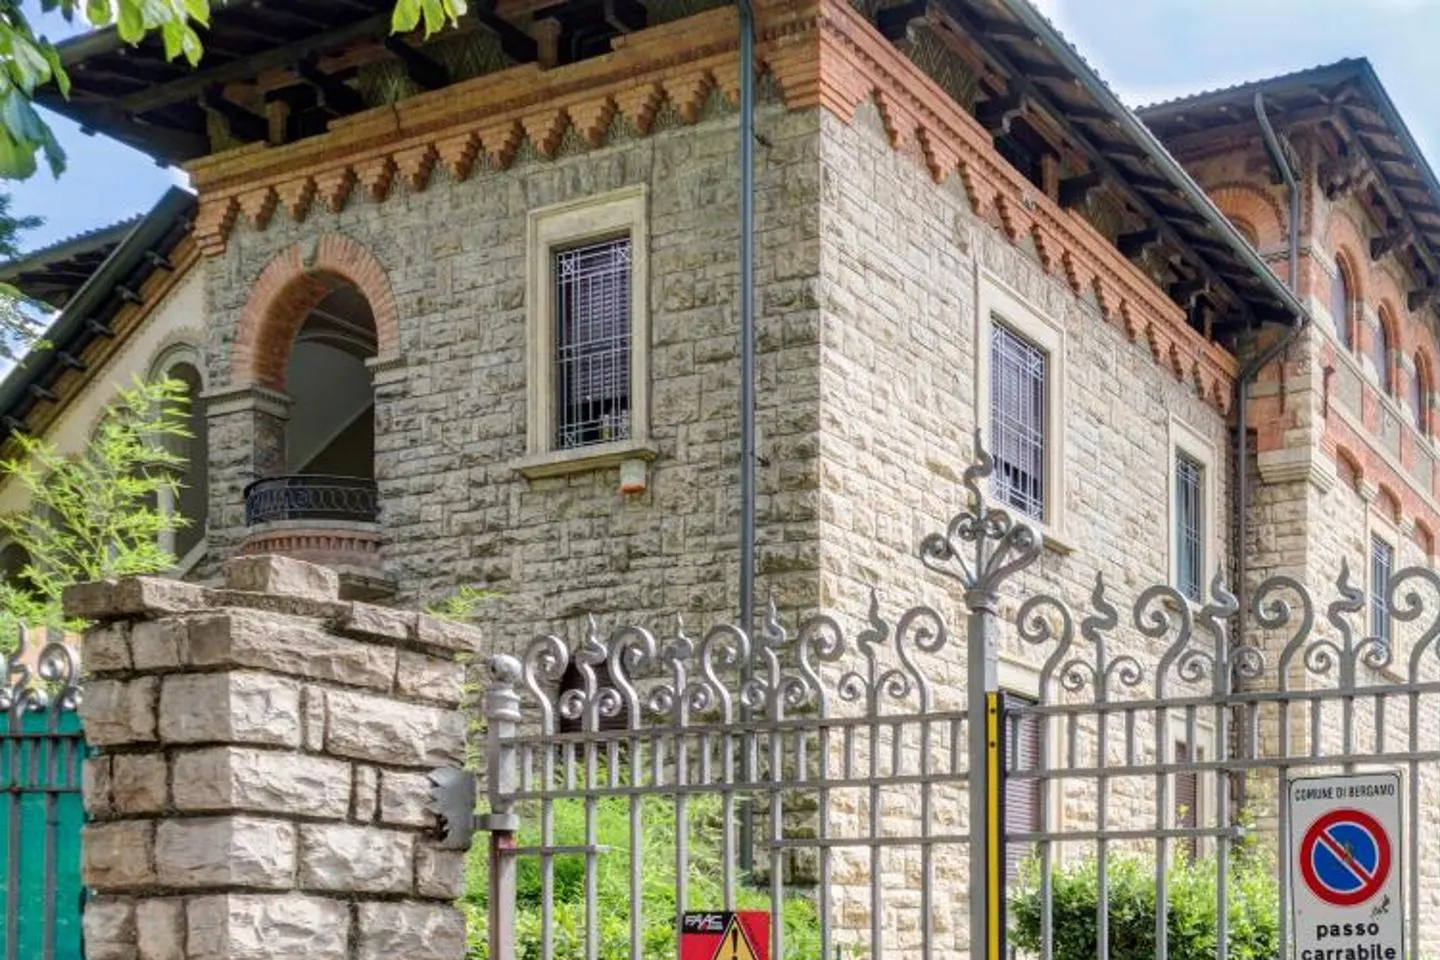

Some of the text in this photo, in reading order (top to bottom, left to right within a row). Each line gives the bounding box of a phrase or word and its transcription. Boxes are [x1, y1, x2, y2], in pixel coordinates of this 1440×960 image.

[1295, 783, 1395, 802] COMUNE DI BERGAMO
[1316, 923, 1379, 941] passo
